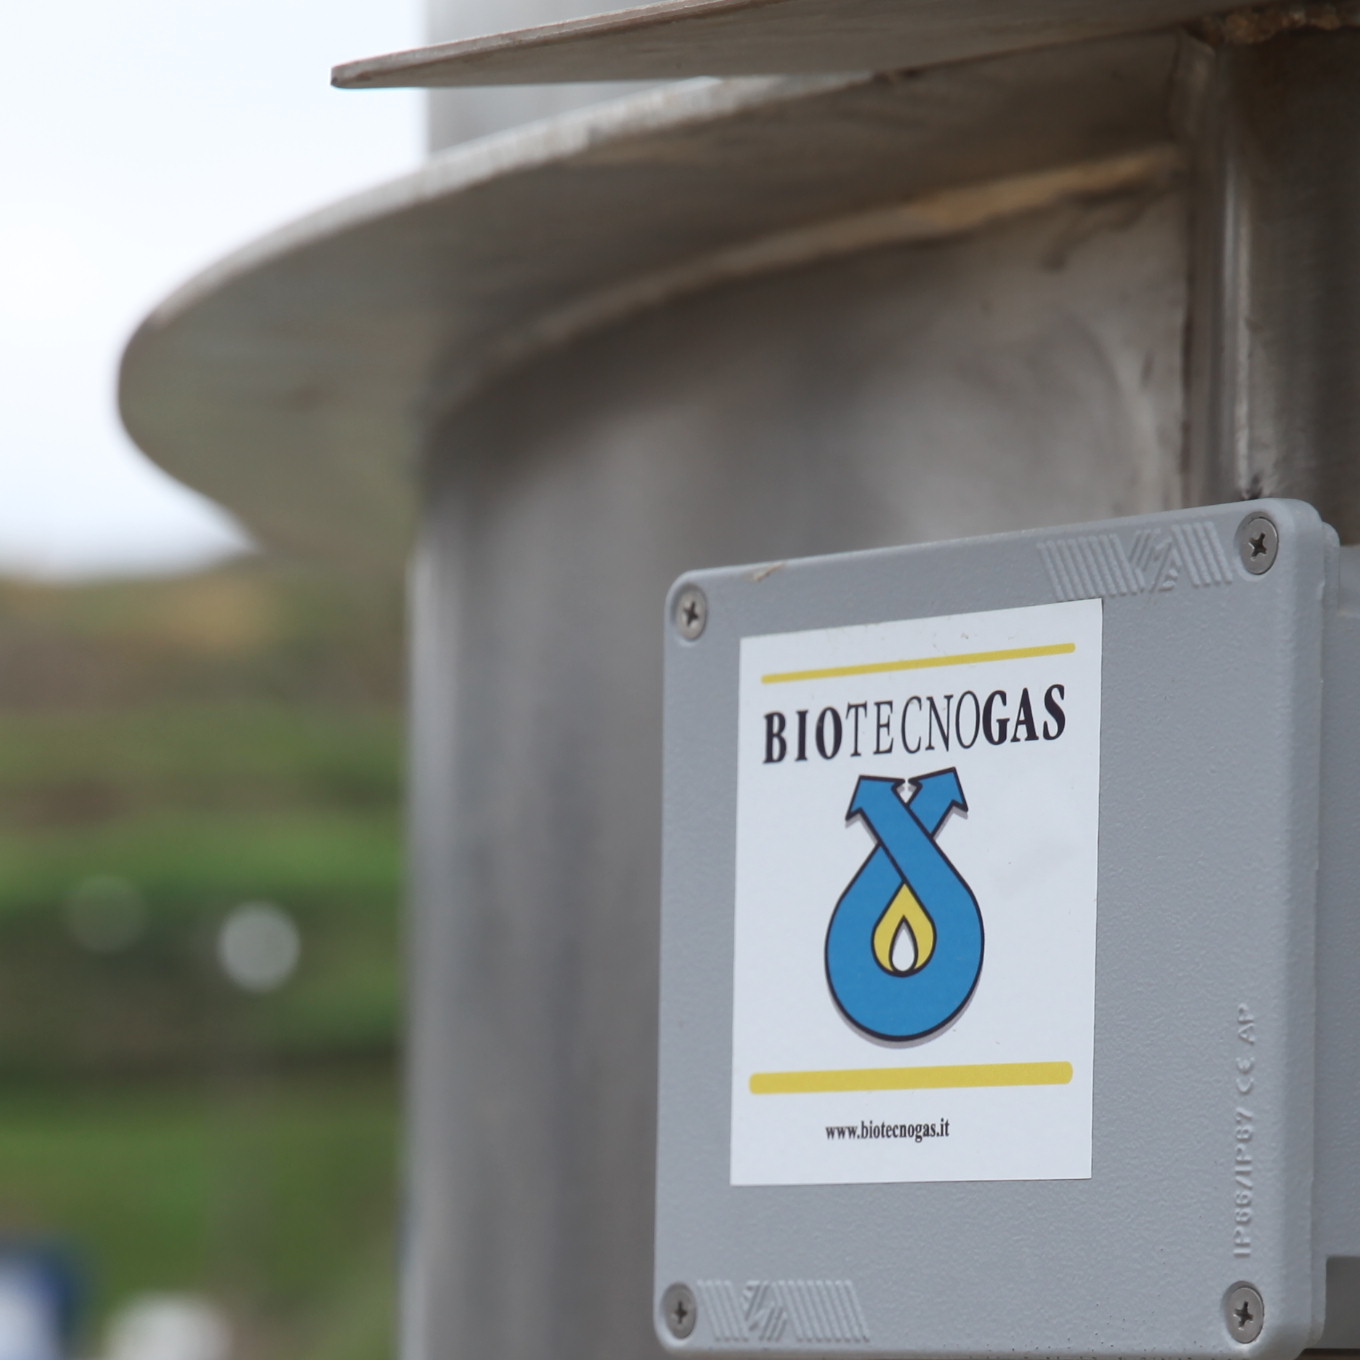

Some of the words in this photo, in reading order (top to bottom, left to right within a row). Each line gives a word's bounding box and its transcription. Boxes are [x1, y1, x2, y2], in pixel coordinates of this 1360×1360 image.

[763, 683, 1067, 764] BIOTECNOGAS
[825, 1117, 950, 1143] www.biotecnogas.it
[1234, 1106, 1254, 1259] IP66/IP67
